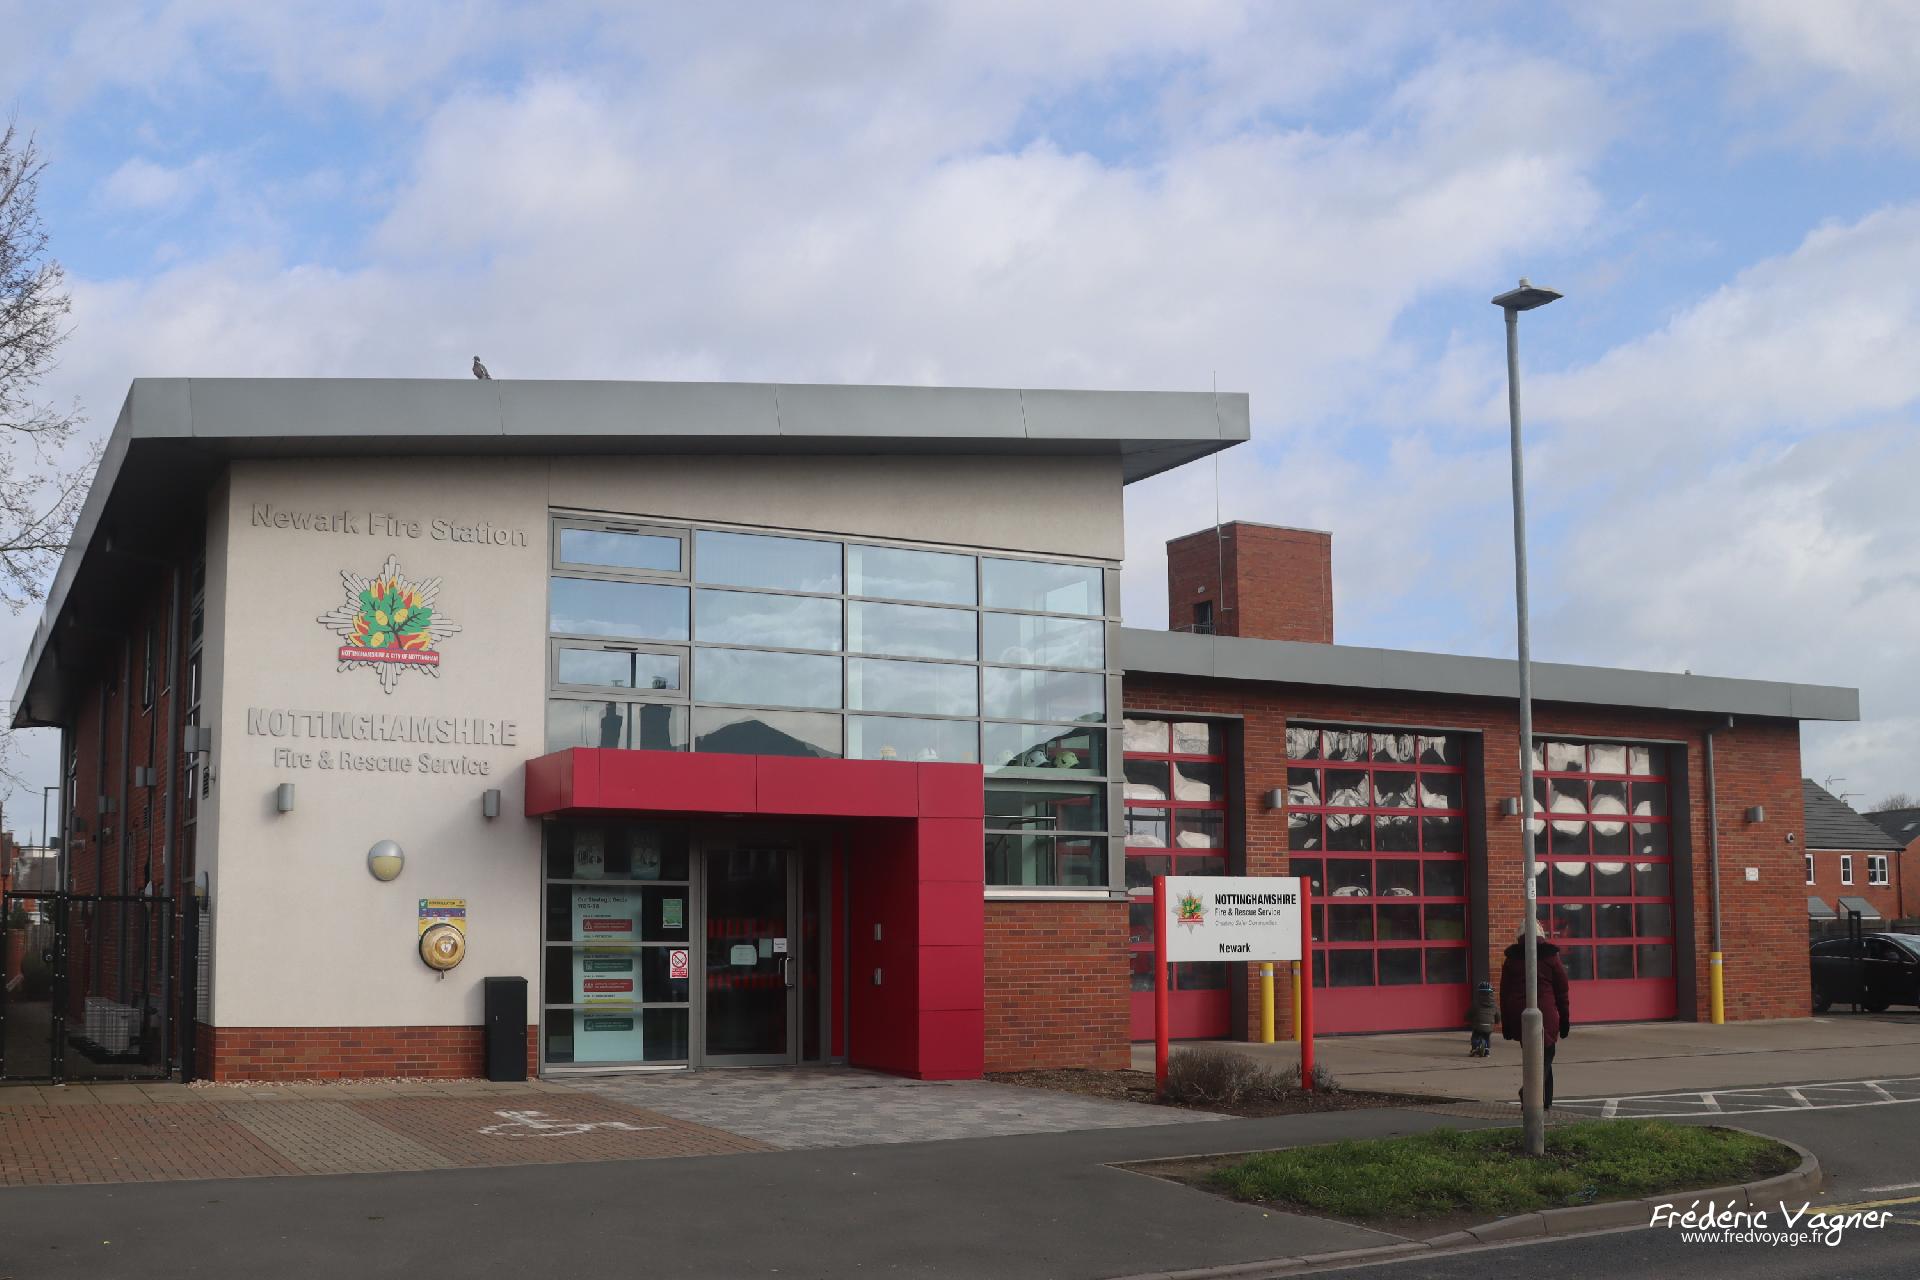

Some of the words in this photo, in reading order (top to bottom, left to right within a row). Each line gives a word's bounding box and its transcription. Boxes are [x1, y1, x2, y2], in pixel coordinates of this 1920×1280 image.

[251, 504, 360, 534] Newark
[368, 512, 422, 539] Fire
[430, 517, 529, 547] Station
[248, 707, 518, 747] NOTTINGHAMSHIRE
[273, 747, 312, 770] Fire
[318, 749, 334, 770] &
[340, 751, 412, 773] Rescue
[418, 753, 491, 776] Service
[1215, 893, 1297, 905] NOTTINGHAMSHIRE
[1215, 908, 1227, 916] Fire
[1227, 908, 1233, 916] &
[1234, 908, 1257, 916] Rescue
[1257, 908, 1281, 916] Service
[1219, 942, 1251, 953] Newark
